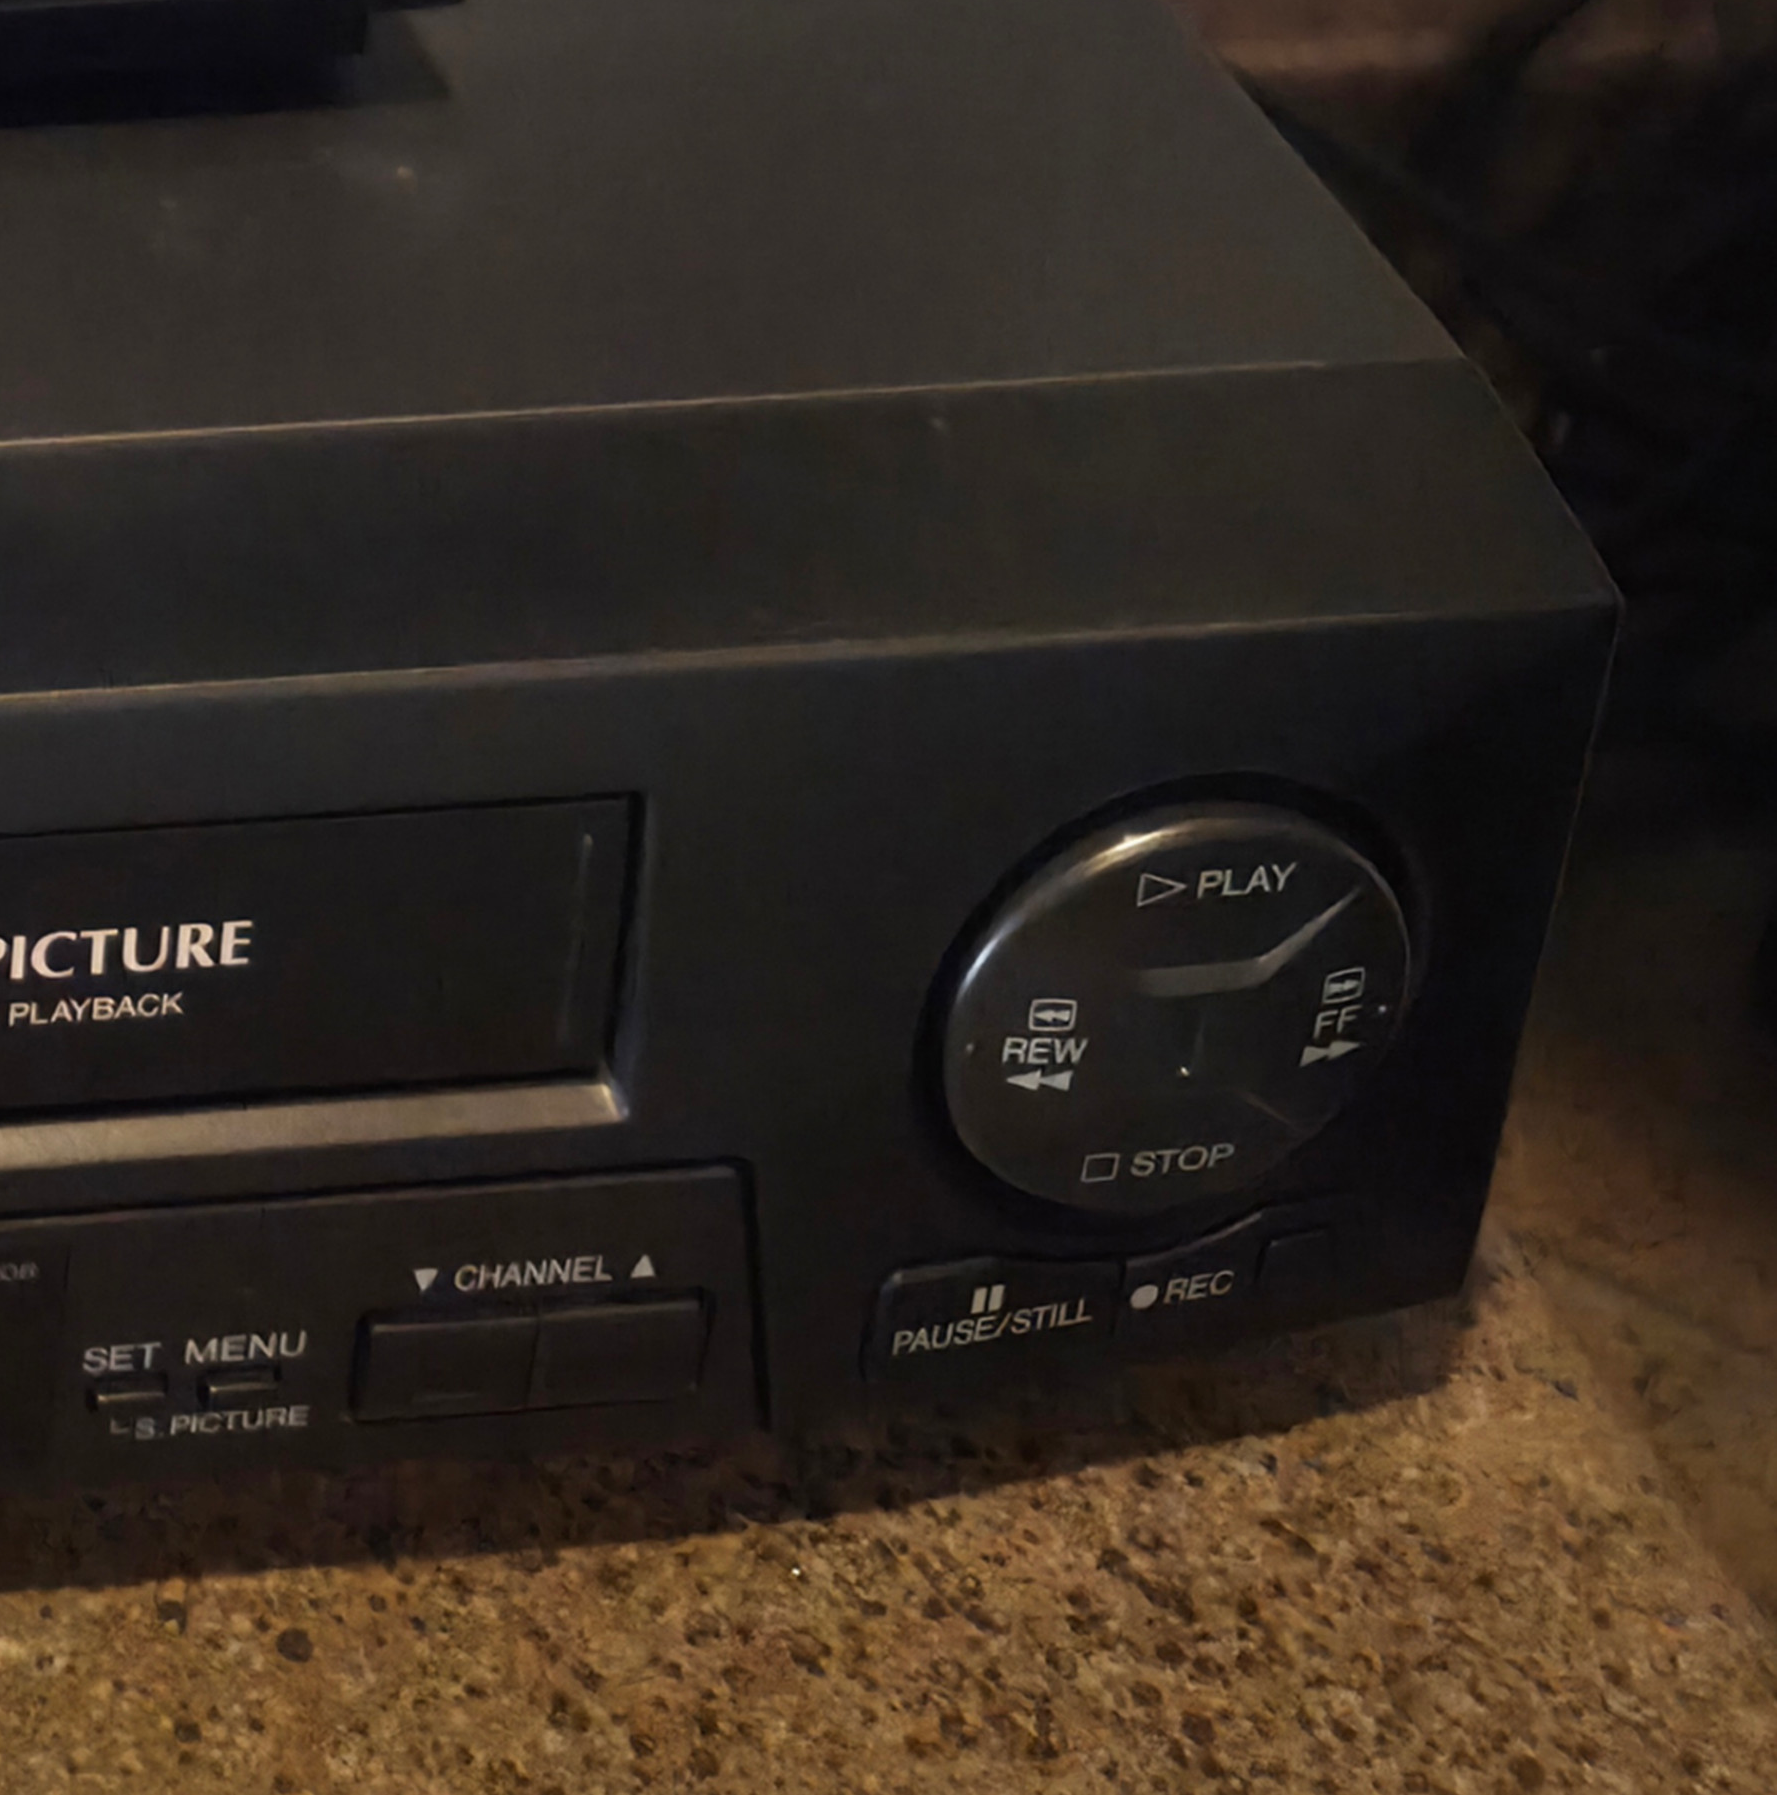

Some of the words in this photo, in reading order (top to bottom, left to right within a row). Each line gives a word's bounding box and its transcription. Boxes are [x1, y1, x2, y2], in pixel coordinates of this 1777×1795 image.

[1197, 862, 1297, 899] PLAY
[8, 992, 183, 1027] PLAYBACK
[1313, 1006, 1362, 1039] FF
[1002, 1036, 1088, 1065] REW
[1130, 1143, 1235, 1177] STOP
[454, 1255, 612, 1292] CHANNEL
[1163, 1269, 1235, 1304] REC
[892, 1298, 1094, 1355] PAUSE/STILL
[82, 1341, 161, 1374] SET
[184, 1330, 307, 1365] MENU
[169, 1405, 308, 1436] PICTURE
